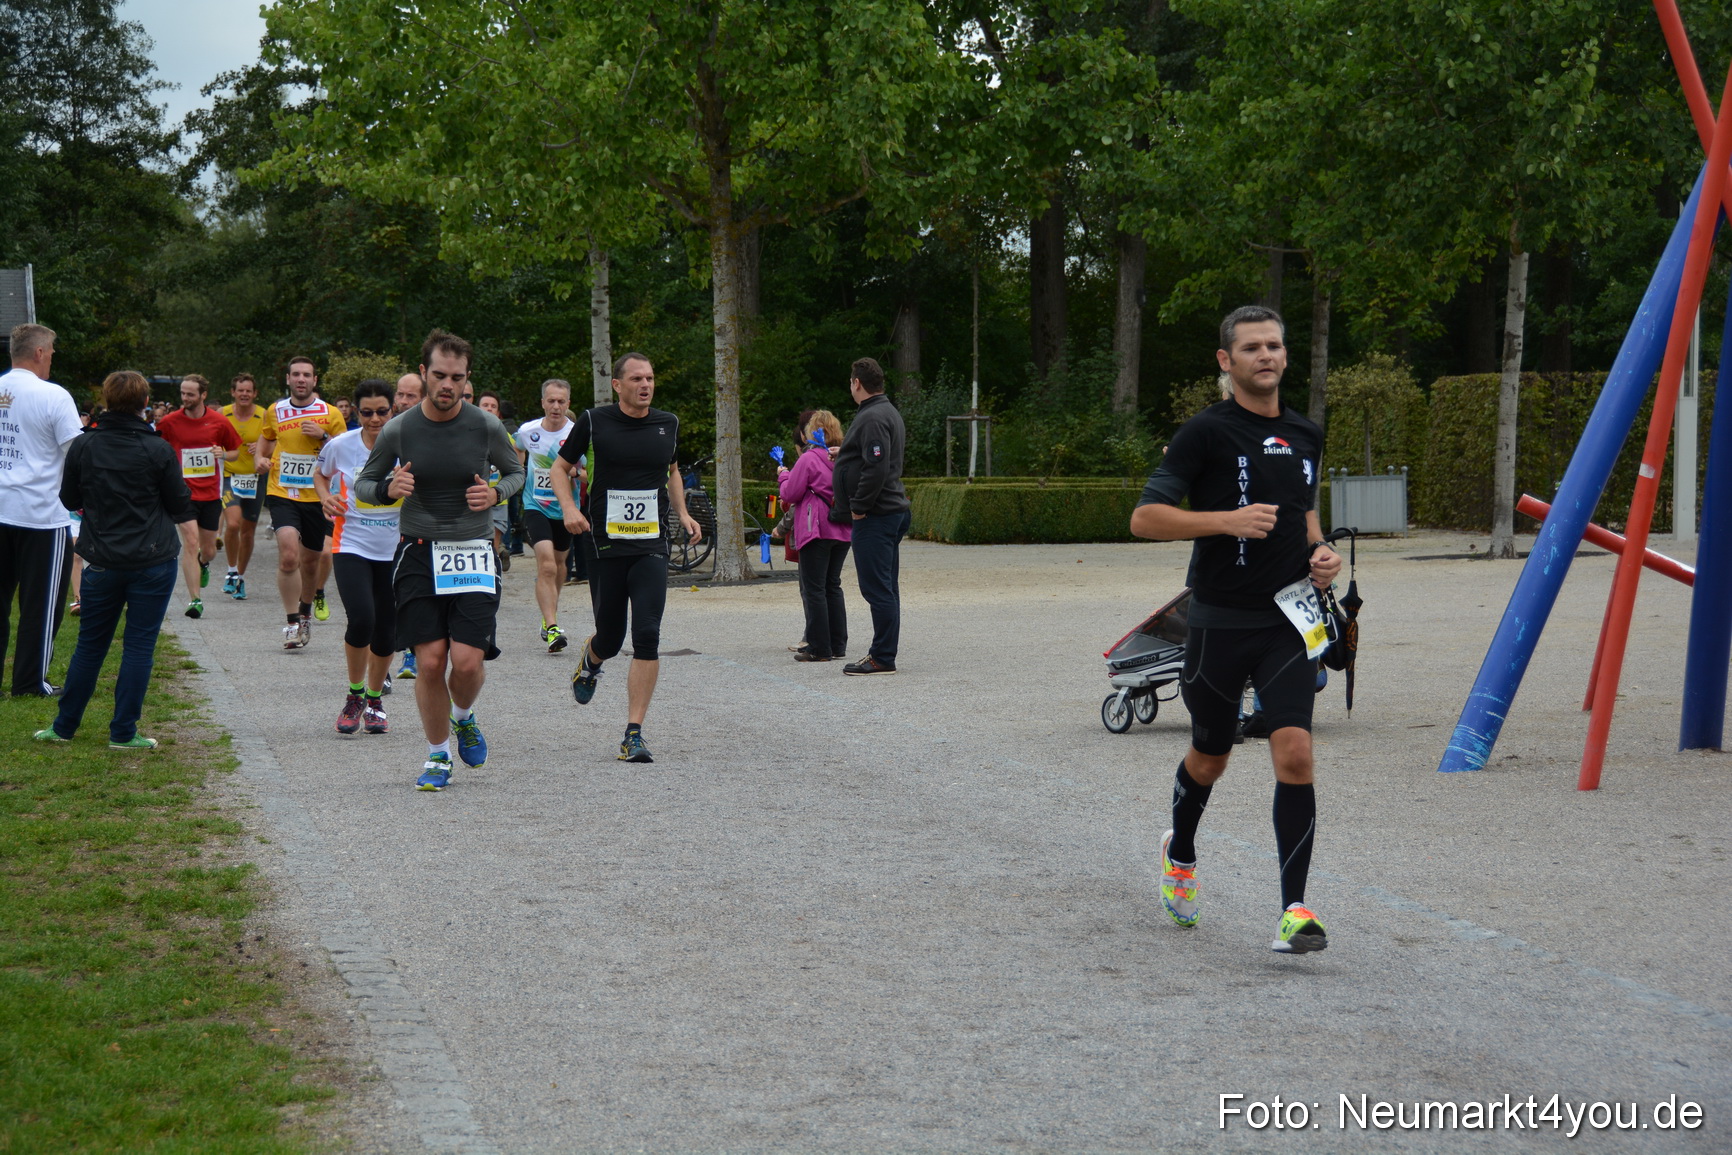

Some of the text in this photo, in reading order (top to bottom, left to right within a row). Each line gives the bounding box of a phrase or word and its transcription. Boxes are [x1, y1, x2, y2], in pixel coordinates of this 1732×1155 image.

[277, 422, 301, 432] MAX
[1263, 447, 1292, 455] skinfit
[189, 455, 209, 467] 151
[283, 461, 313, 475] 2767
[624, 503, 646, 521] 32
[1236, 456, 1249, 566] BAVAIA
[361, 519, 398, 528] SIEMENS
[617, 525, 650, 534] Wolfgang
[440, 553, 489, 572] 2611
[453, 576, 481, 585] Patrick
